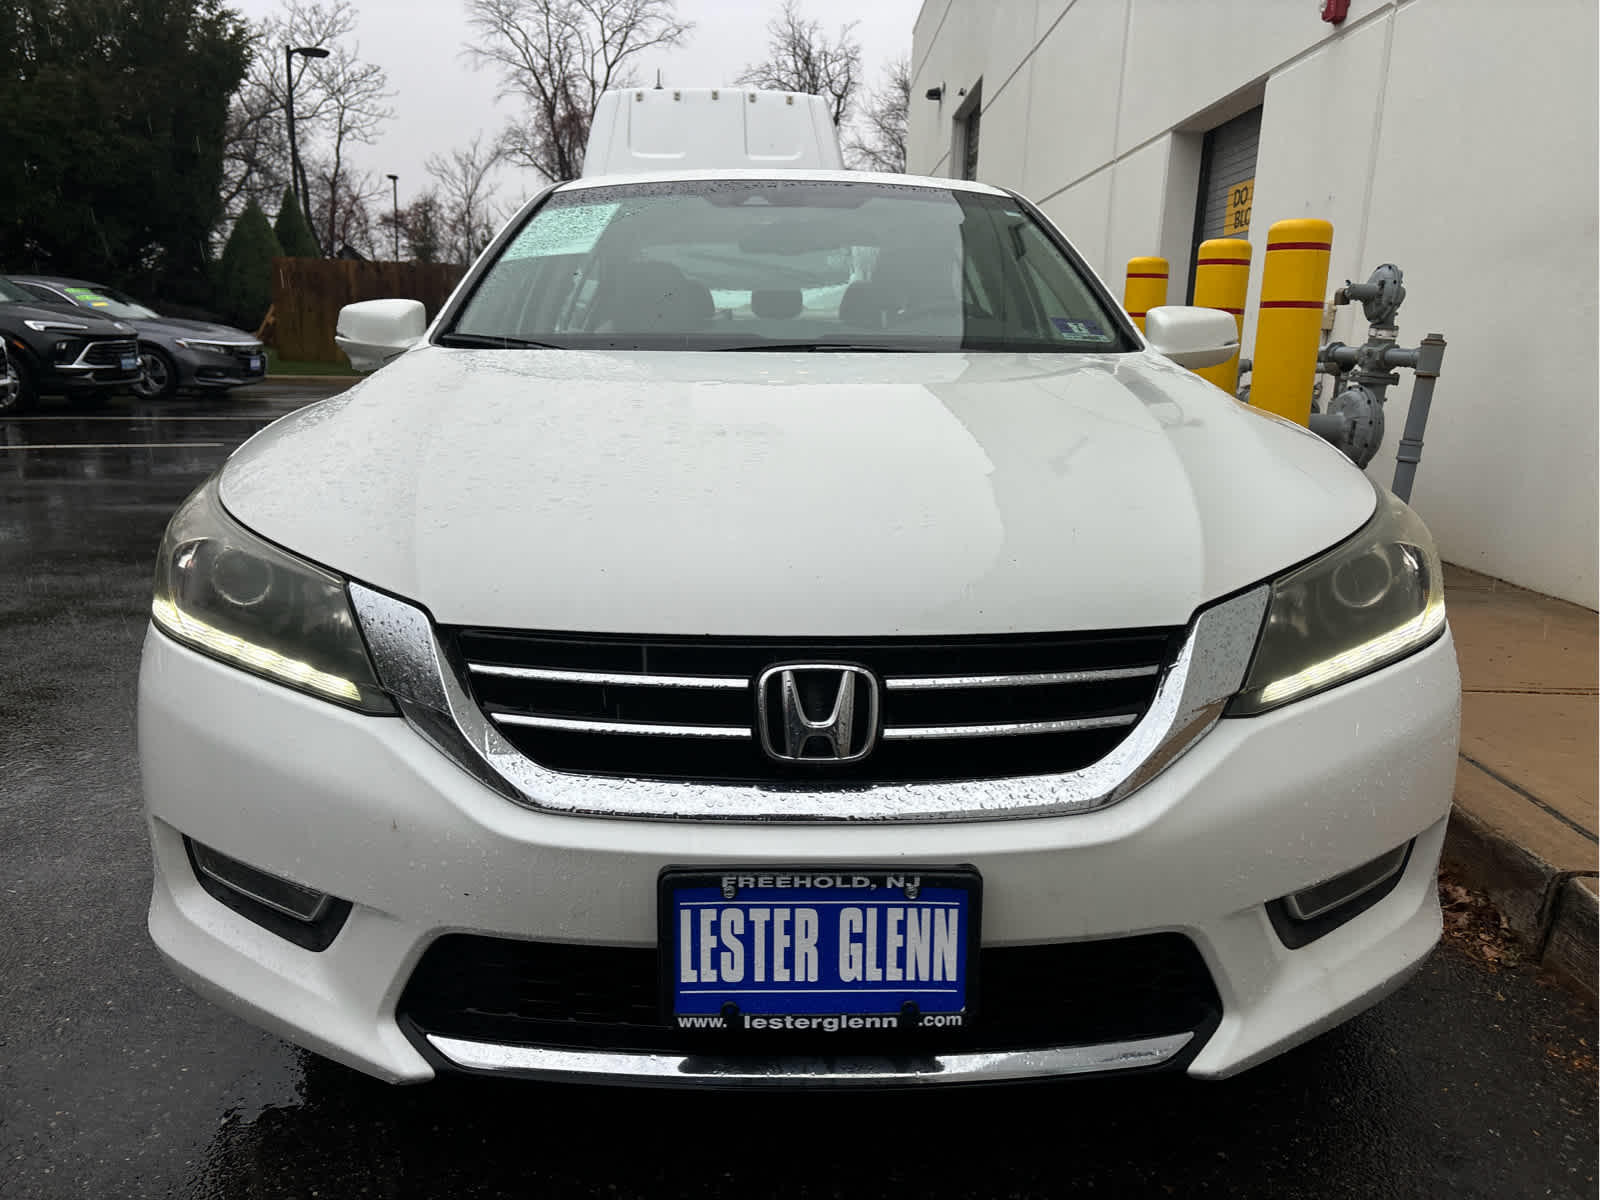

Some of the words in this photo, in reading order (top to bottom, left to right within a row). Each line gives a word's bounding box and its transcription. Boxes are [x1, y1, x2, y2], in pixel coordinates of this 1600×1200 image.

[1233, 187, 1249, 208] DO
[721, 876, 877, 890] FREEHOLD,
[886, 876, 921, 889] NJ
[680, 908, 819, 982] LESTER
[839, 907, 958, 982] GLENN
[678, 1016, 727, 1029] www.
[744, 1015, 898, 1032] lesterglenn
